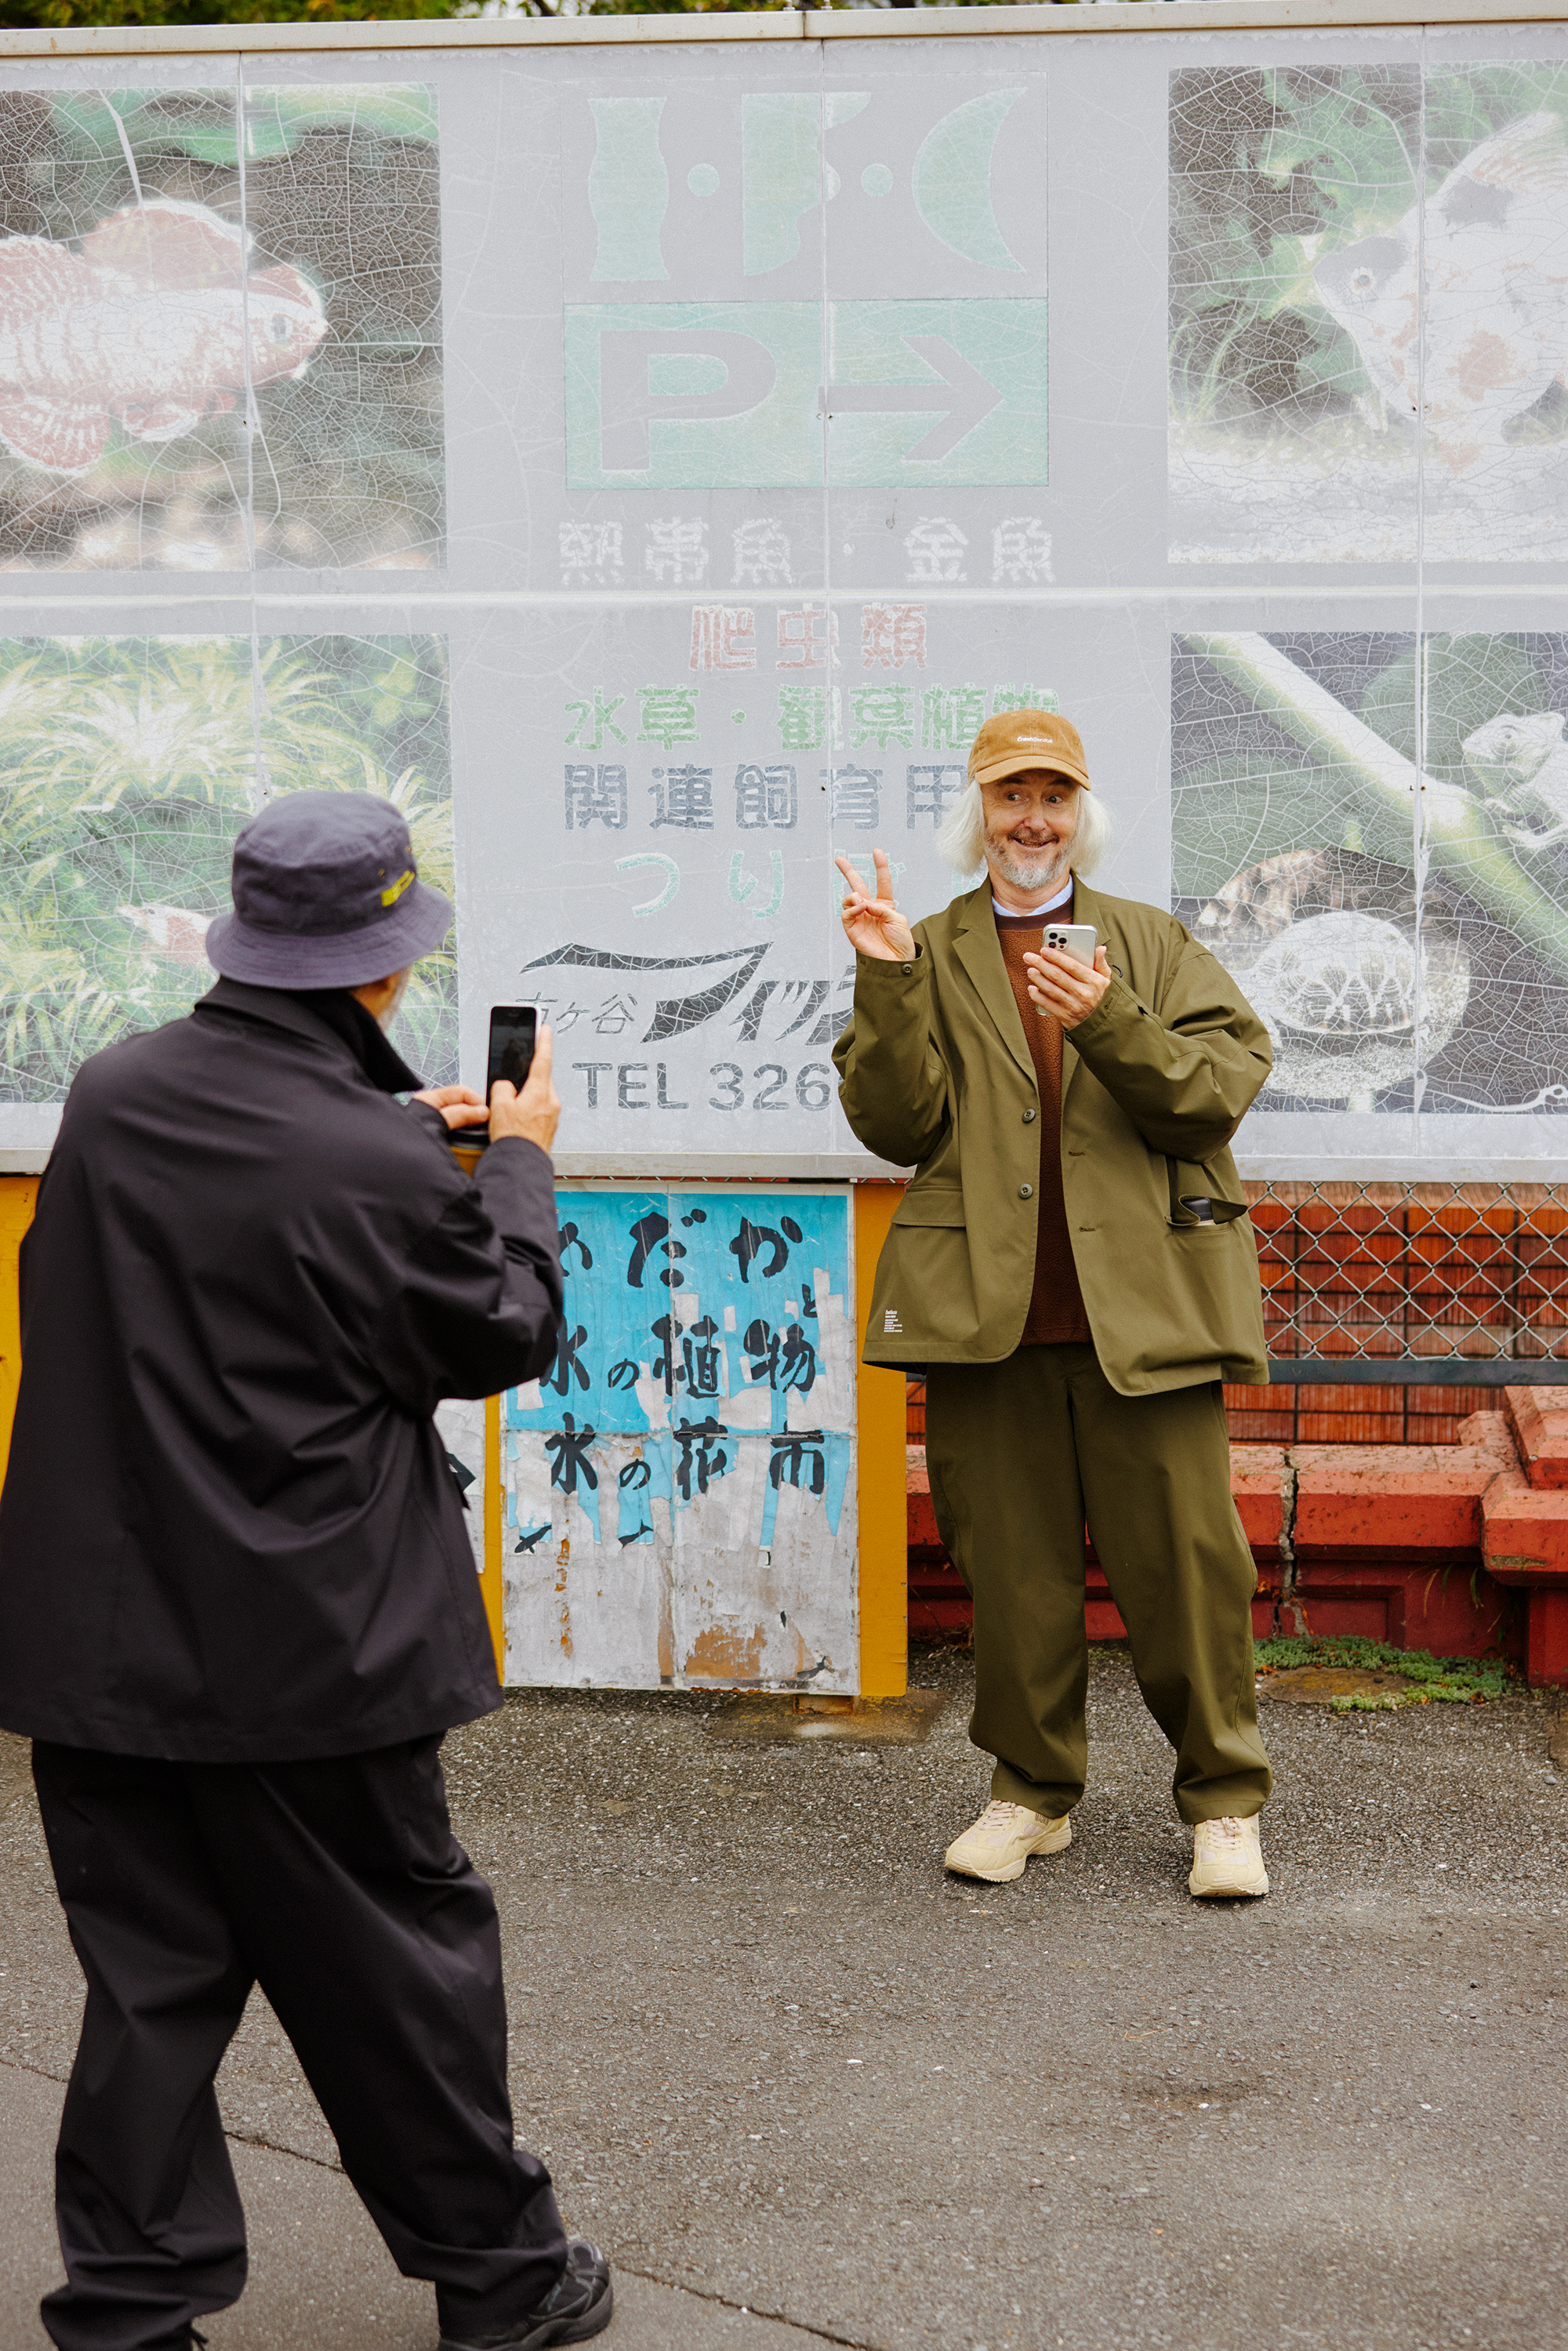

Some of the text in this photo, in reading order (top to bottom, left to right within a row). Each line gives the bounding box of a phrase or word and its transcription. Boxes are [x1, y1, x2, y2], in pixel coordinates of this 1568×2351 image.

[599, 329, 777, 470] P
[688, 602, 927, 671] 爬虫類
[572, 1062, 844, 1112] TEL 326
